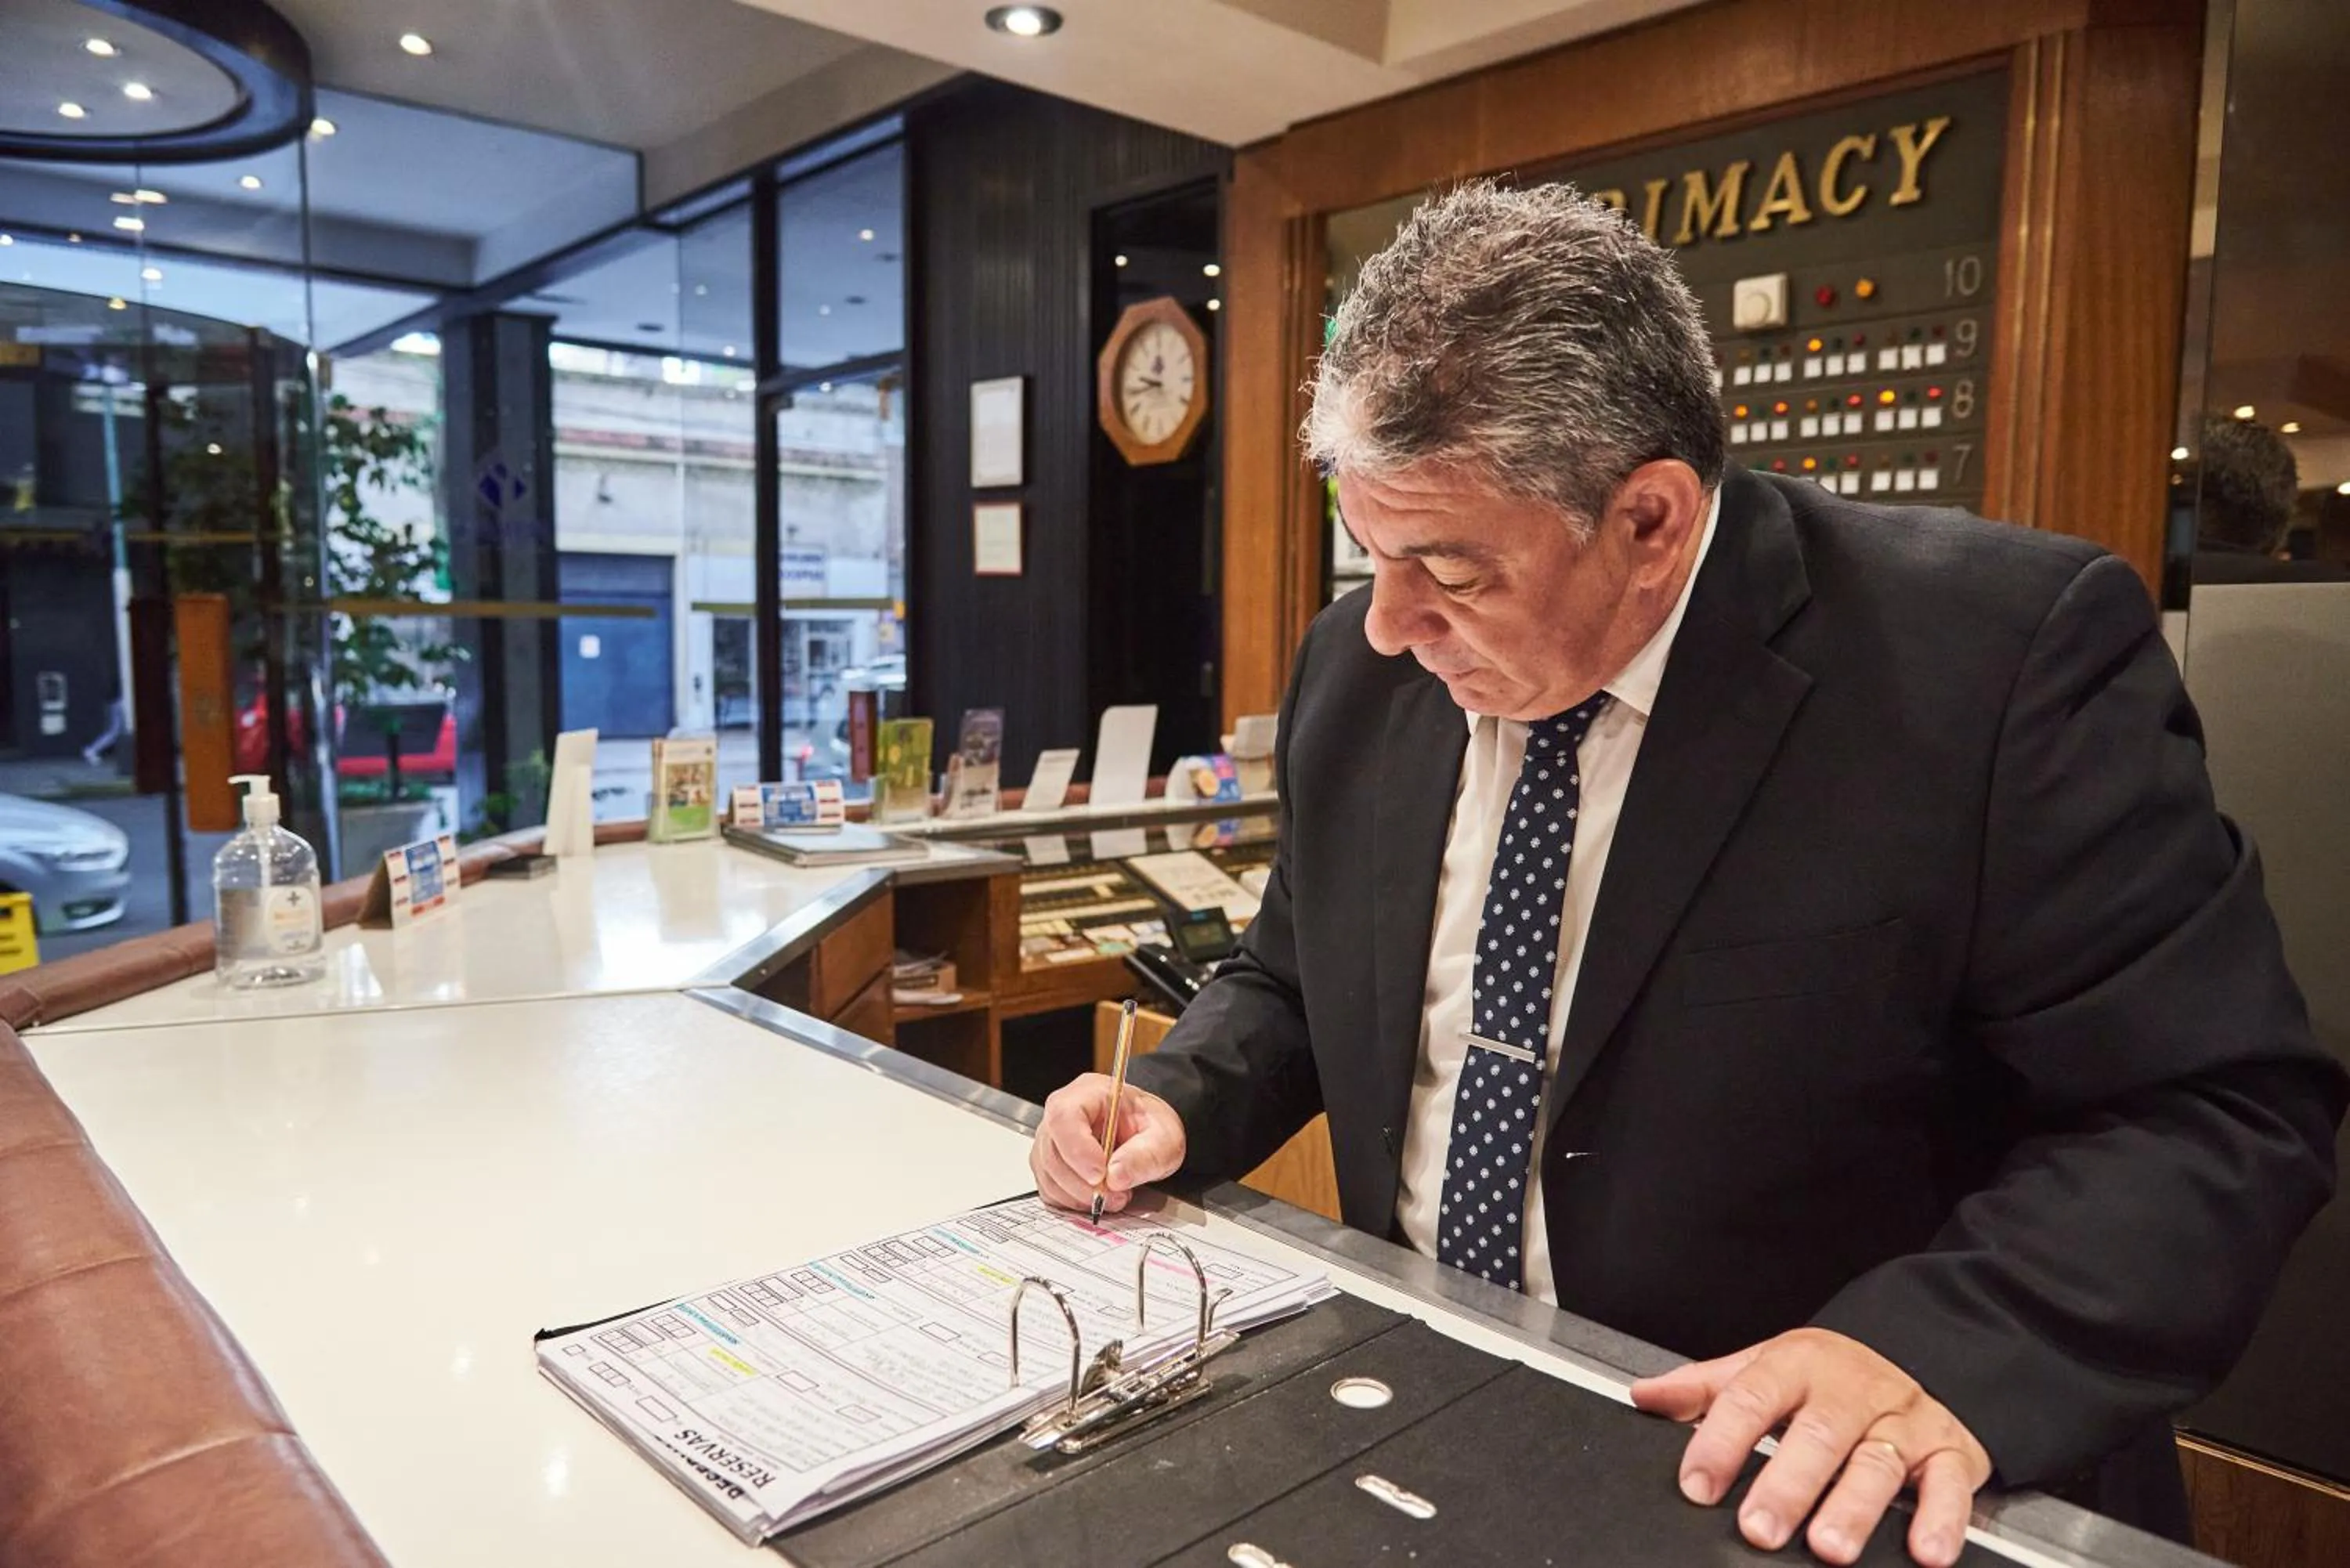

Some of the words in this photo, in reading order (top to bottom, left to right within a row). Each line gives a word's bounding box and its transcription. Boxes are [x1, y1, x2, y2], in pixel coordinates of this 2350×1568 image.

[1944, 255, 1982, 298] 10
[1955, 319, 1978, 357] 9
[1951, 378, 1975, 419] 8
[1952, 443, 1973, 484] 7
[674, 1429, 776, 1489] RESERVAS
